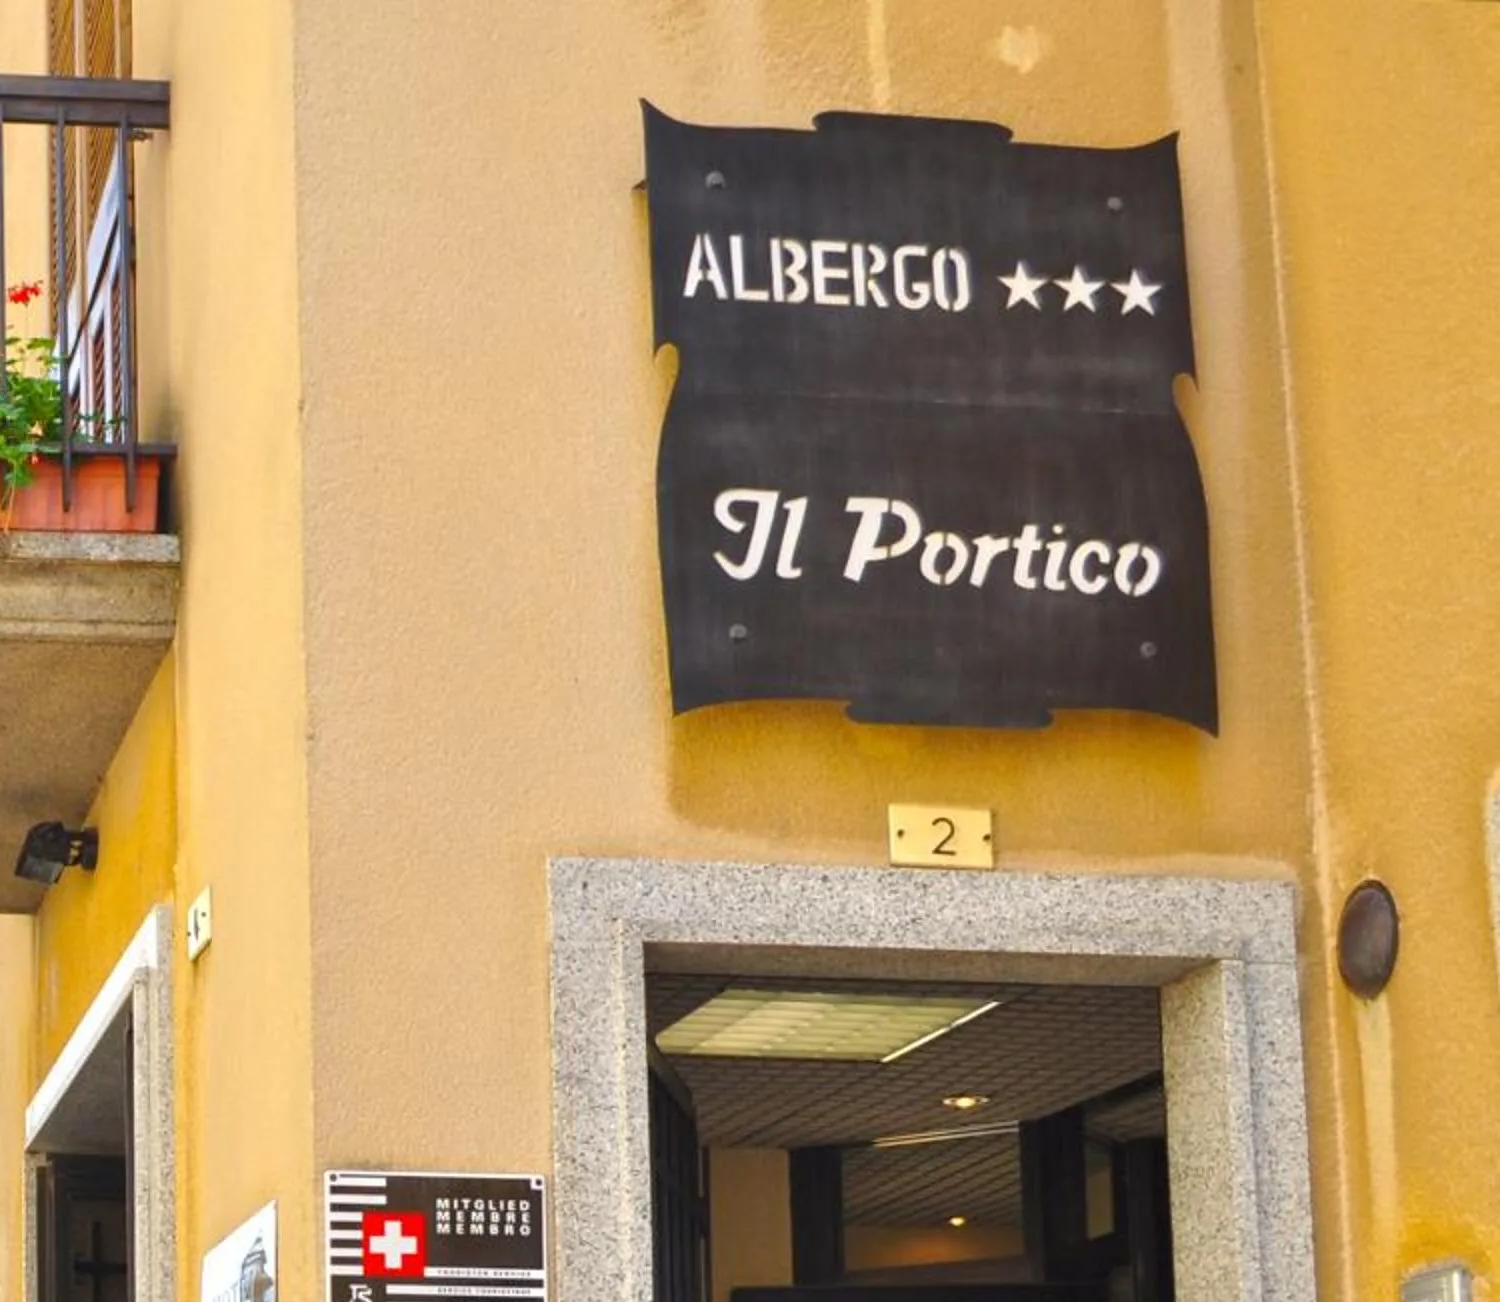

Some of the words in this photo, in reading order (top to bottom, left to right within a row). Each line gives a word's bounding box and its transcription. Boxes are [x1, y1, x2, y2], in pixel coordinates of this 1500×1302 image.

[683, 232, 972, 313] ALBERGO
[712, 487, 809, 582] Il
[842, 496, 1162, 598] Portico
[931, 816, 957, 857] 2
[435, 1198, 531, 1212] MITGLIED
[435, 1211, 531, 1224] MEMBRE
[435, 1223, 532, 1237] MEMBRO
